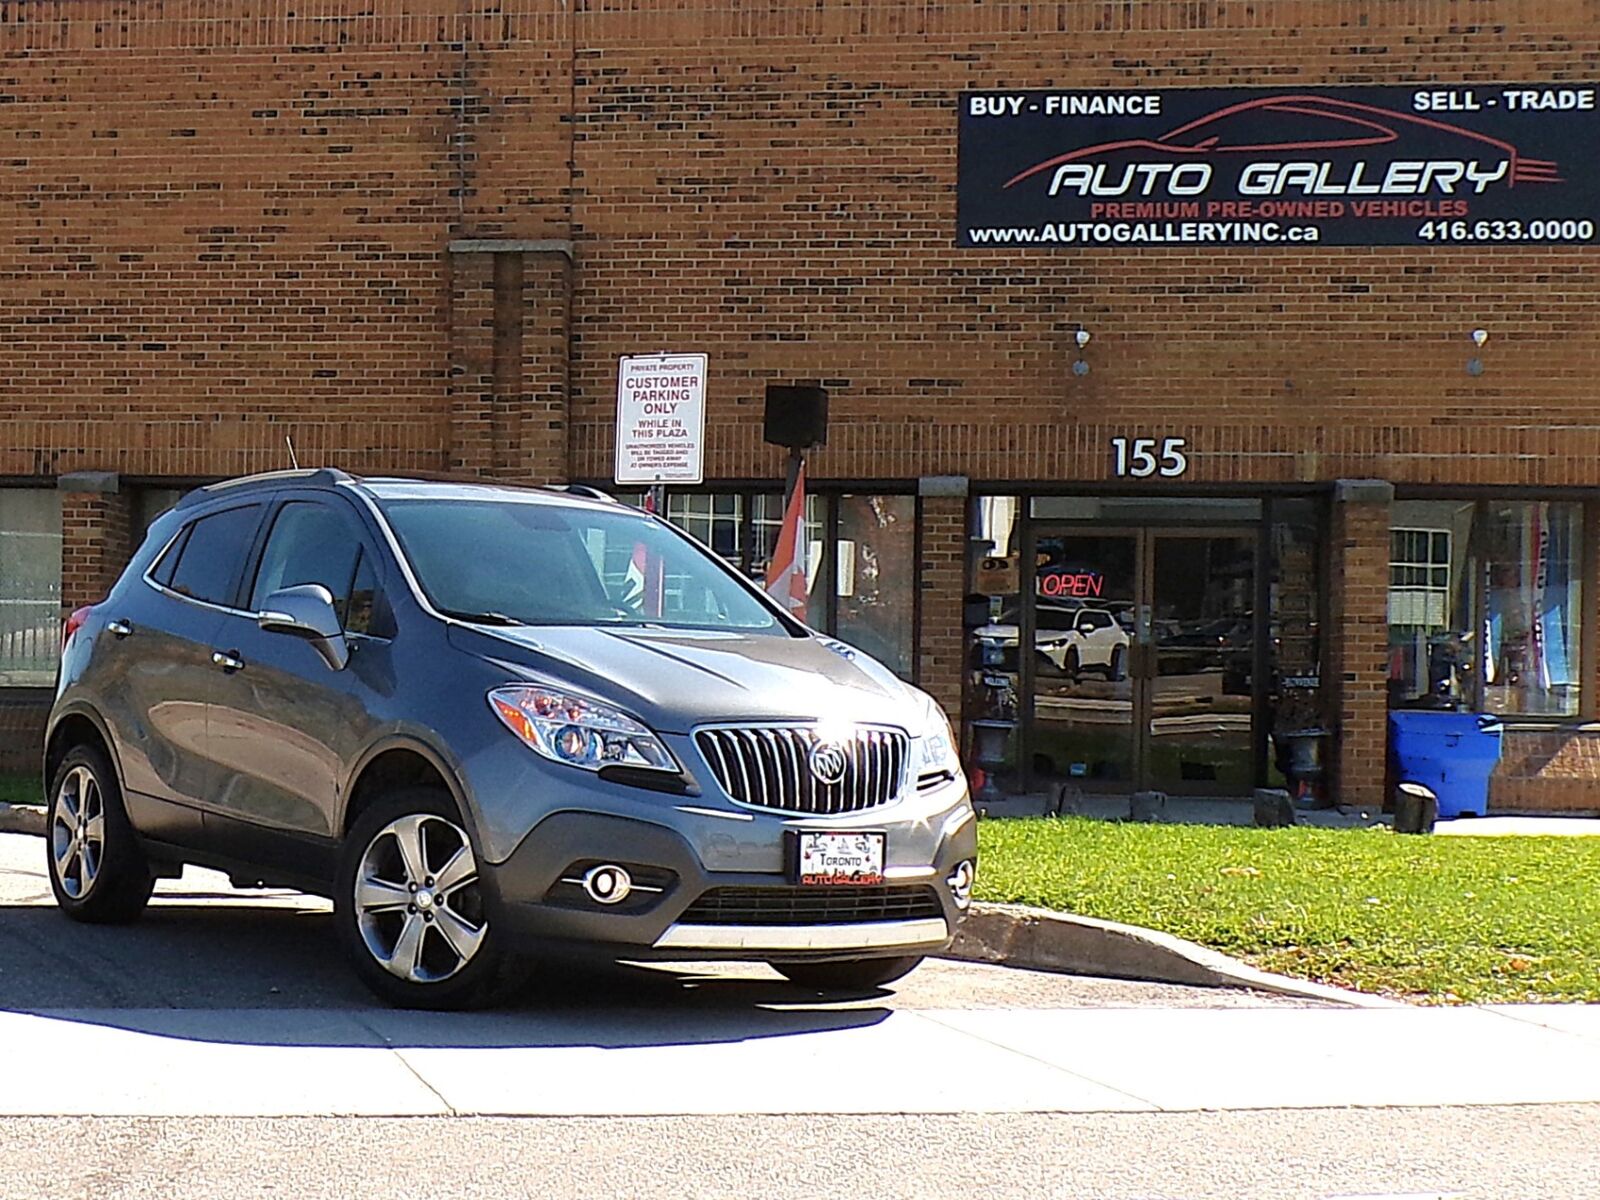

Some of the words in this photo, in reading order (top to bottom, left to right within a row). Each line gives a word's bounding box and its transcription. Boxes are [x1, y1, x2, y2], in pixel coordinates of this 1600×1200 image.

[969, 96, 1025, 115] BUY
[1045, 95, 1161, 115] FINANCE
[1413, 91, 1481, 111] SELL
[1502, 90, 1595, 110] TRADE
[1048, 163, 1212, 196] AUTO
[1237, 161, 1510, 196] GALLERY
[1090, 202, 1200, 219] PREMIUM
[1206, 201, 1345, 218] PRE-OWNED
[1350, 200, 1469, 217] VEHICLES
[969, 221, 1319, 243] www.AUTOGALLERYINC.ca
[1418, 220, 1594, 241] 416.633.0000
[630, 364, 657, 372] PRIVATE
[659, 363, 694, 371] PROPERTY
[625, 376, 699, 389] CUSTOMER
[632, 389, 690, 402] PARKING
[643, 402, 678, 414] ONLY
[638, 420, 668, 428] WHILE
[671, 419, 682, 428] IN
[632, 429, 654, 438] THIS
[656, 429, 688, 438] PLAZA
[1112, 438, 1188, 478] 155
[1042, 573, 1104, 597] OPEN
